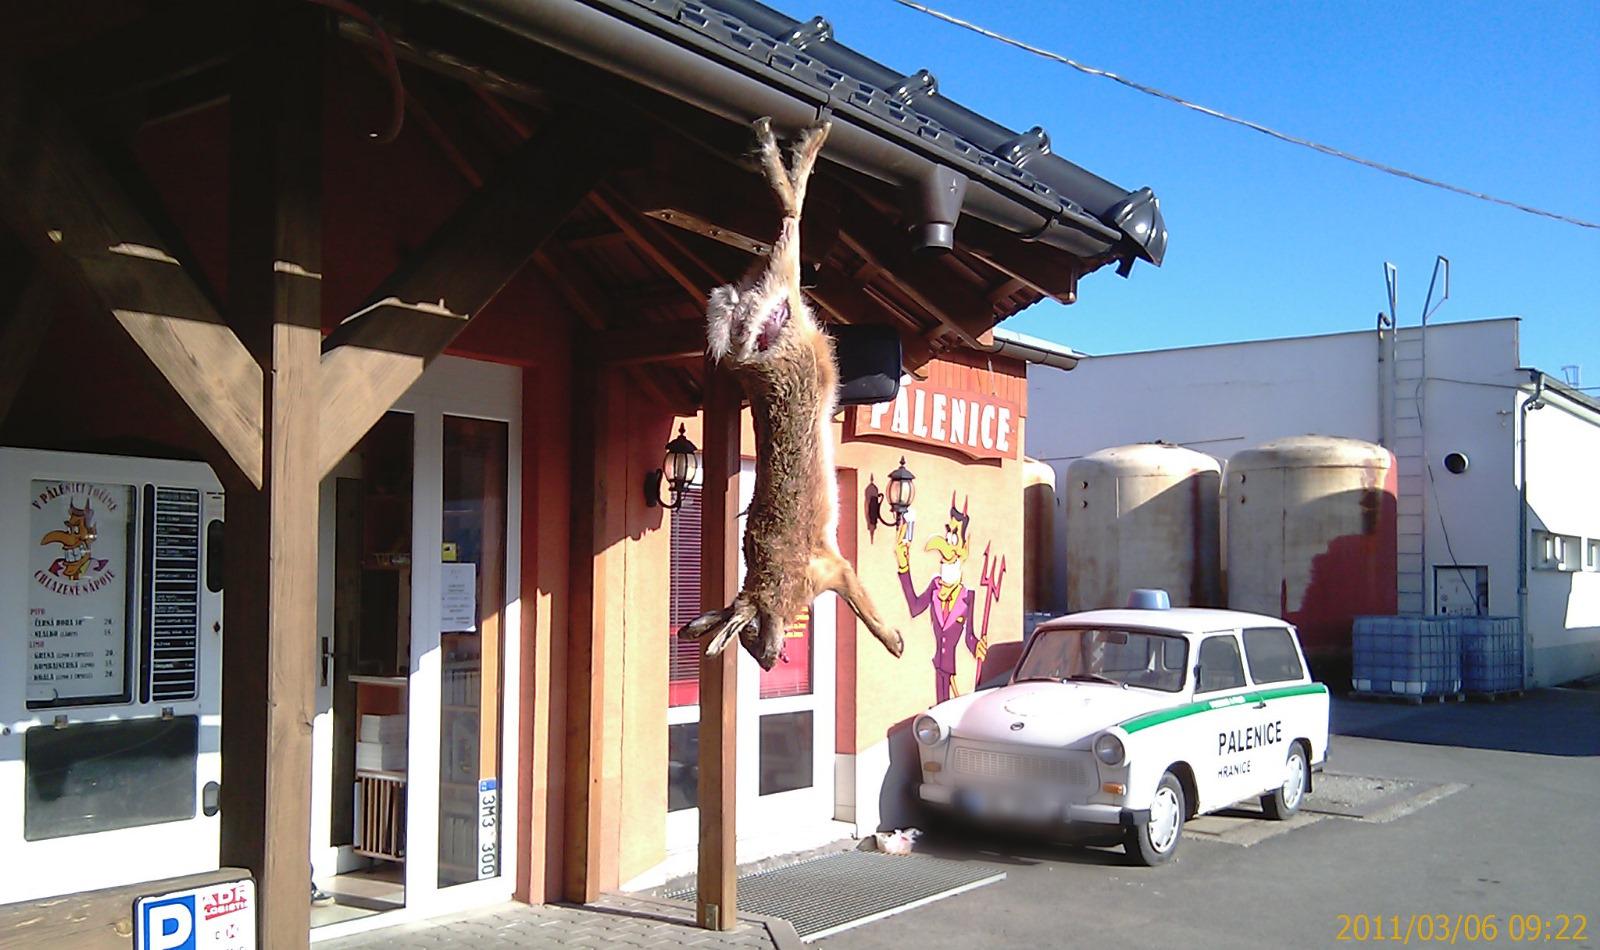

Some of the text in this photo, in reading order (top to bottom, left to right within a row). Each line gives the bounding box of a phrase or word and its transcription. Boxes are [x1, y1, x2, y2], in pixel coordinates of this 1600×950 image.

[34, 570, 115, 596] CHLAZENÉ NÁPOJE
[1218, 720, 1282, 756] PALENICE
[1217, 759, 1251, 779] HRANICE
[481, 795, 496, 876] 3M3 300
[148, 903, 193, 950] P
